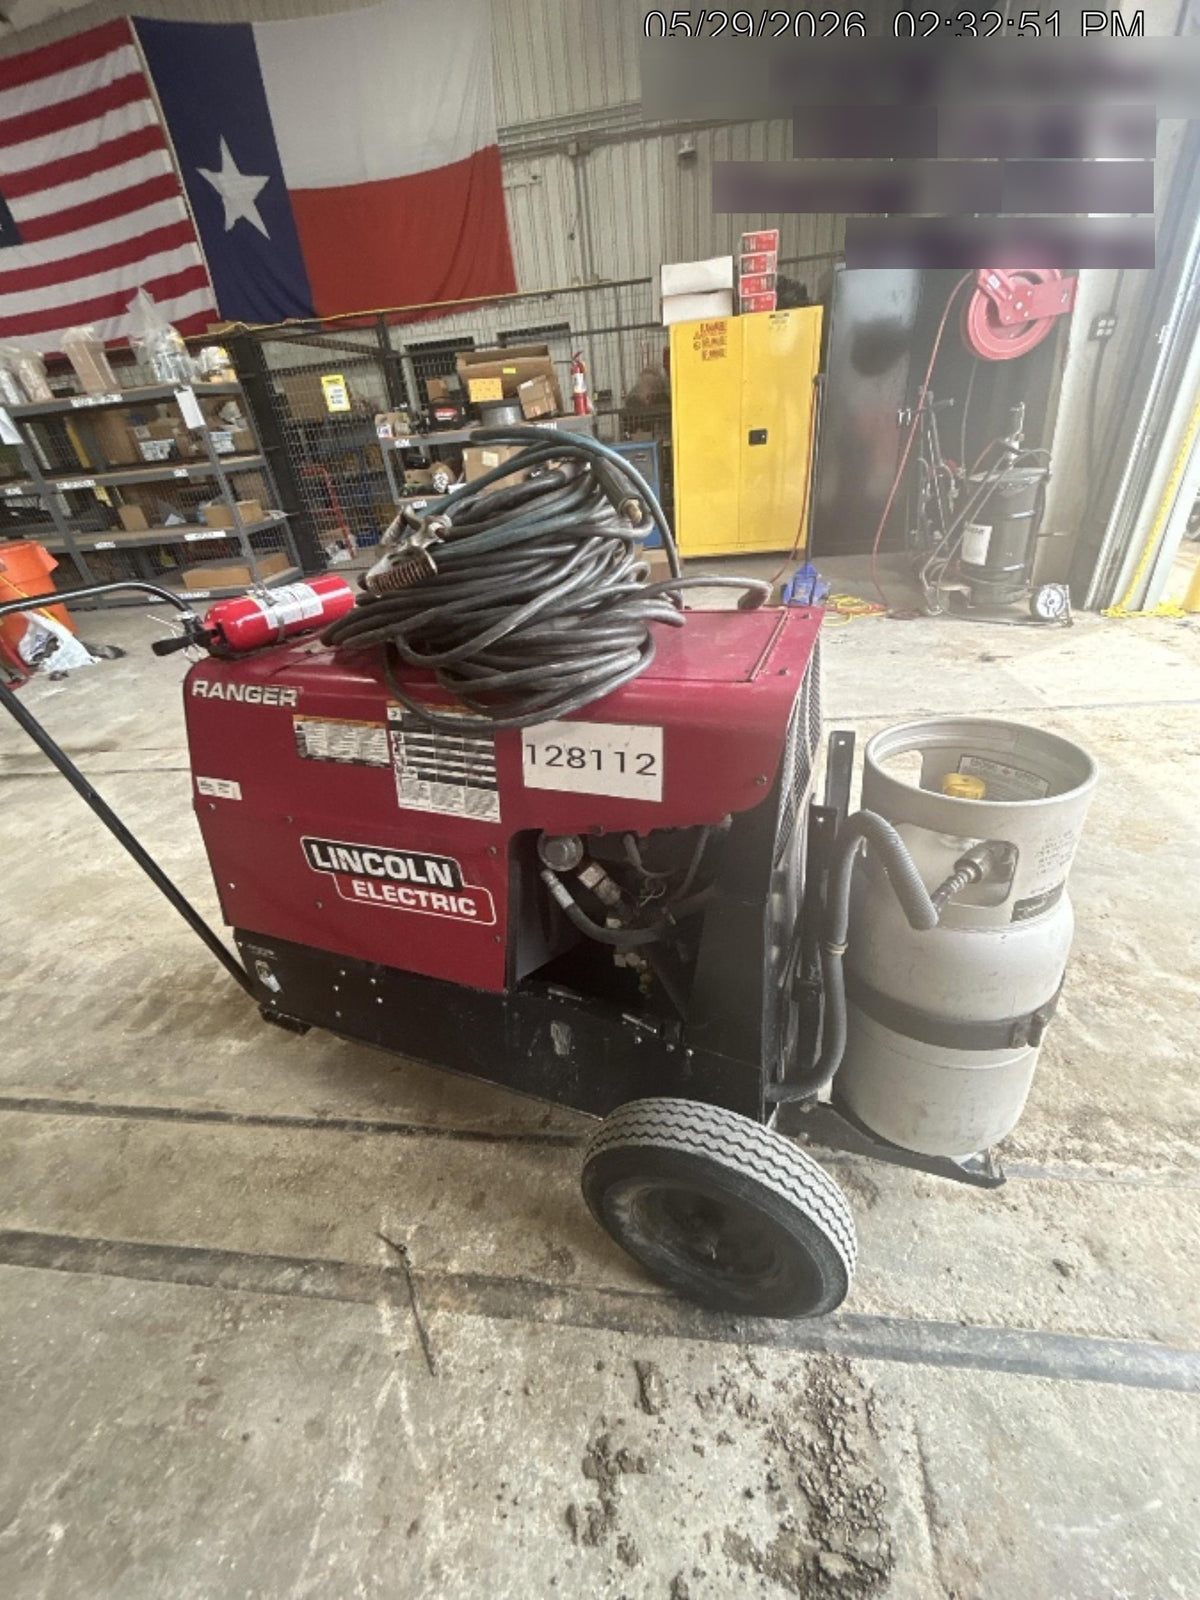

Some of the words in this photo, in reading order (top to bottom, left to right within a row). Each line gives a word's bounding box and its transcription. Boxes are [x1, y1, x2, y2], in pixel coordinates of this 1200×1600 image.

[191, 680, 298, 707] RANGER
[525, 744, 657, 776] 128112
[310, 843, 455, 888] LINCOLN
[351, 879, 478, 917] ELECTRIC
